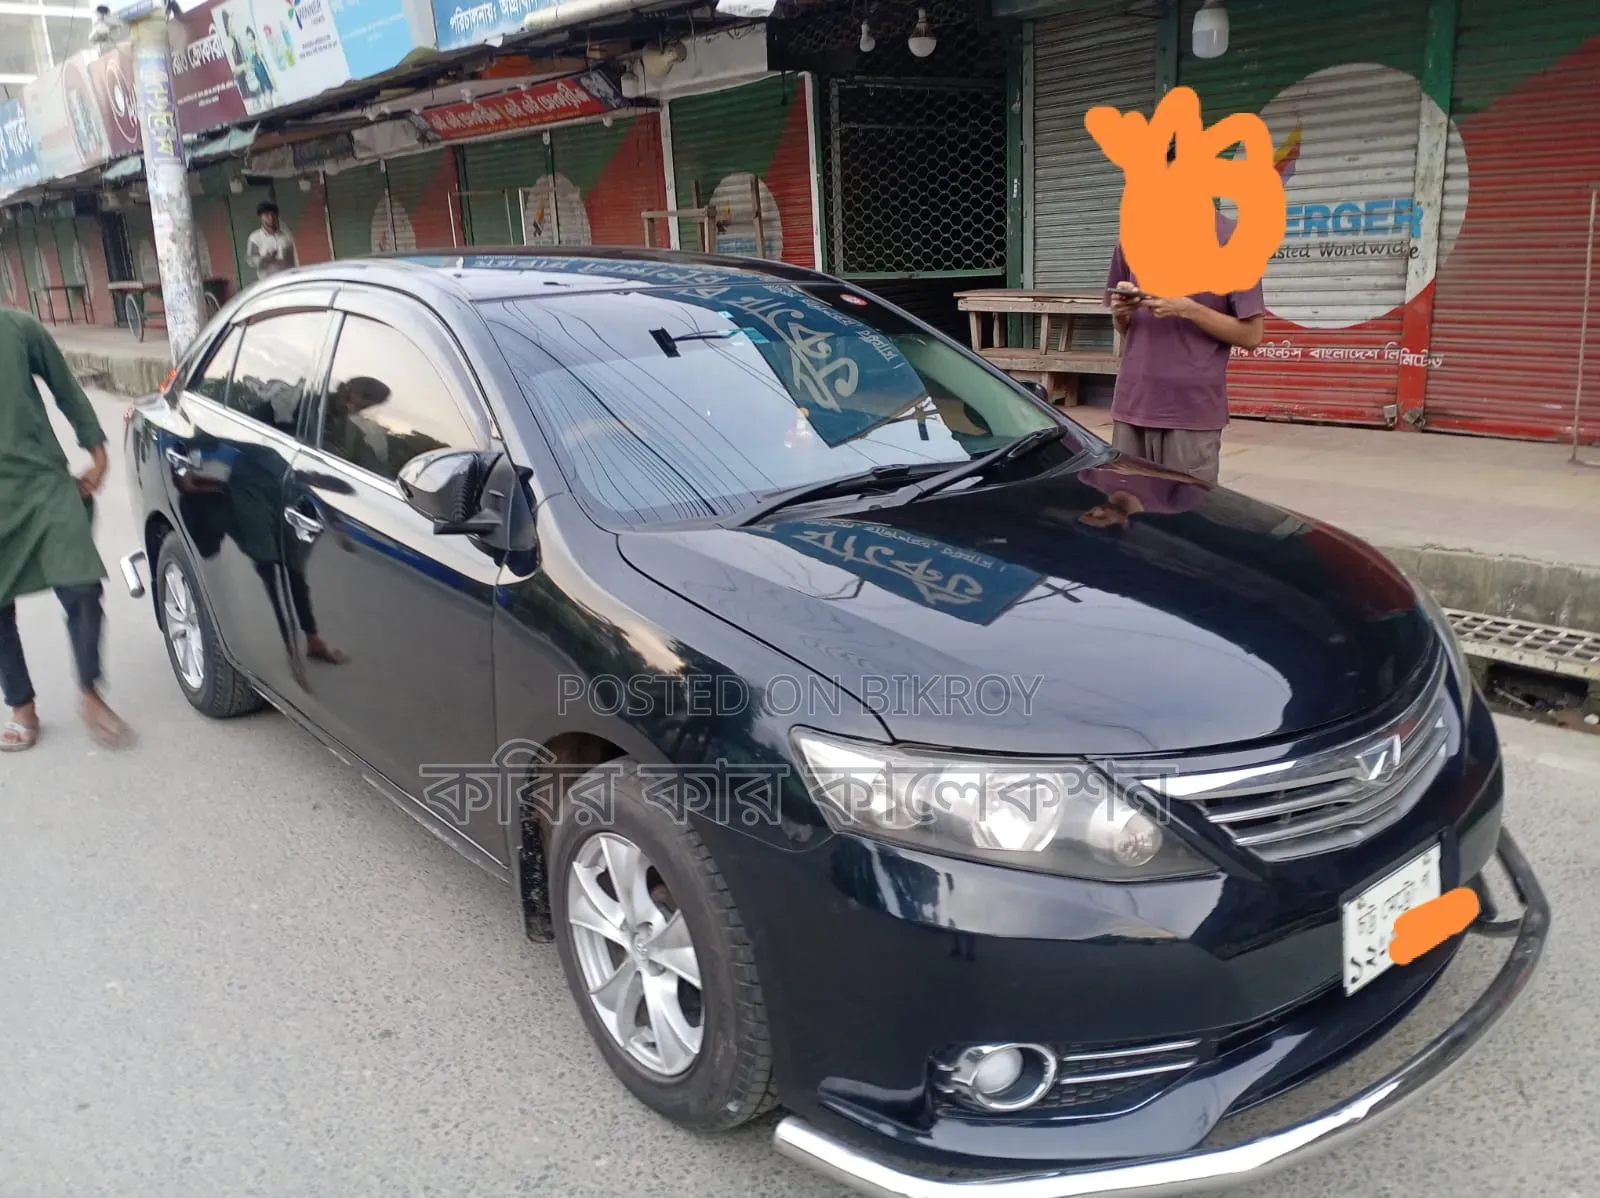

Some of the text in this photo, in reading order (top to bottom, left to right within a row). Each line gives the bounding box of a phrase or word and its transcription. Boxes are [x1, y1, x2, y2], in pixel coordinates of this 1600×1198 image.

[1286, 199, 1423, 239] ERGER
[1320, 240, 1419, 259] Worldwide
[1309, 346, 1379, 361] বাংলাদেশ
